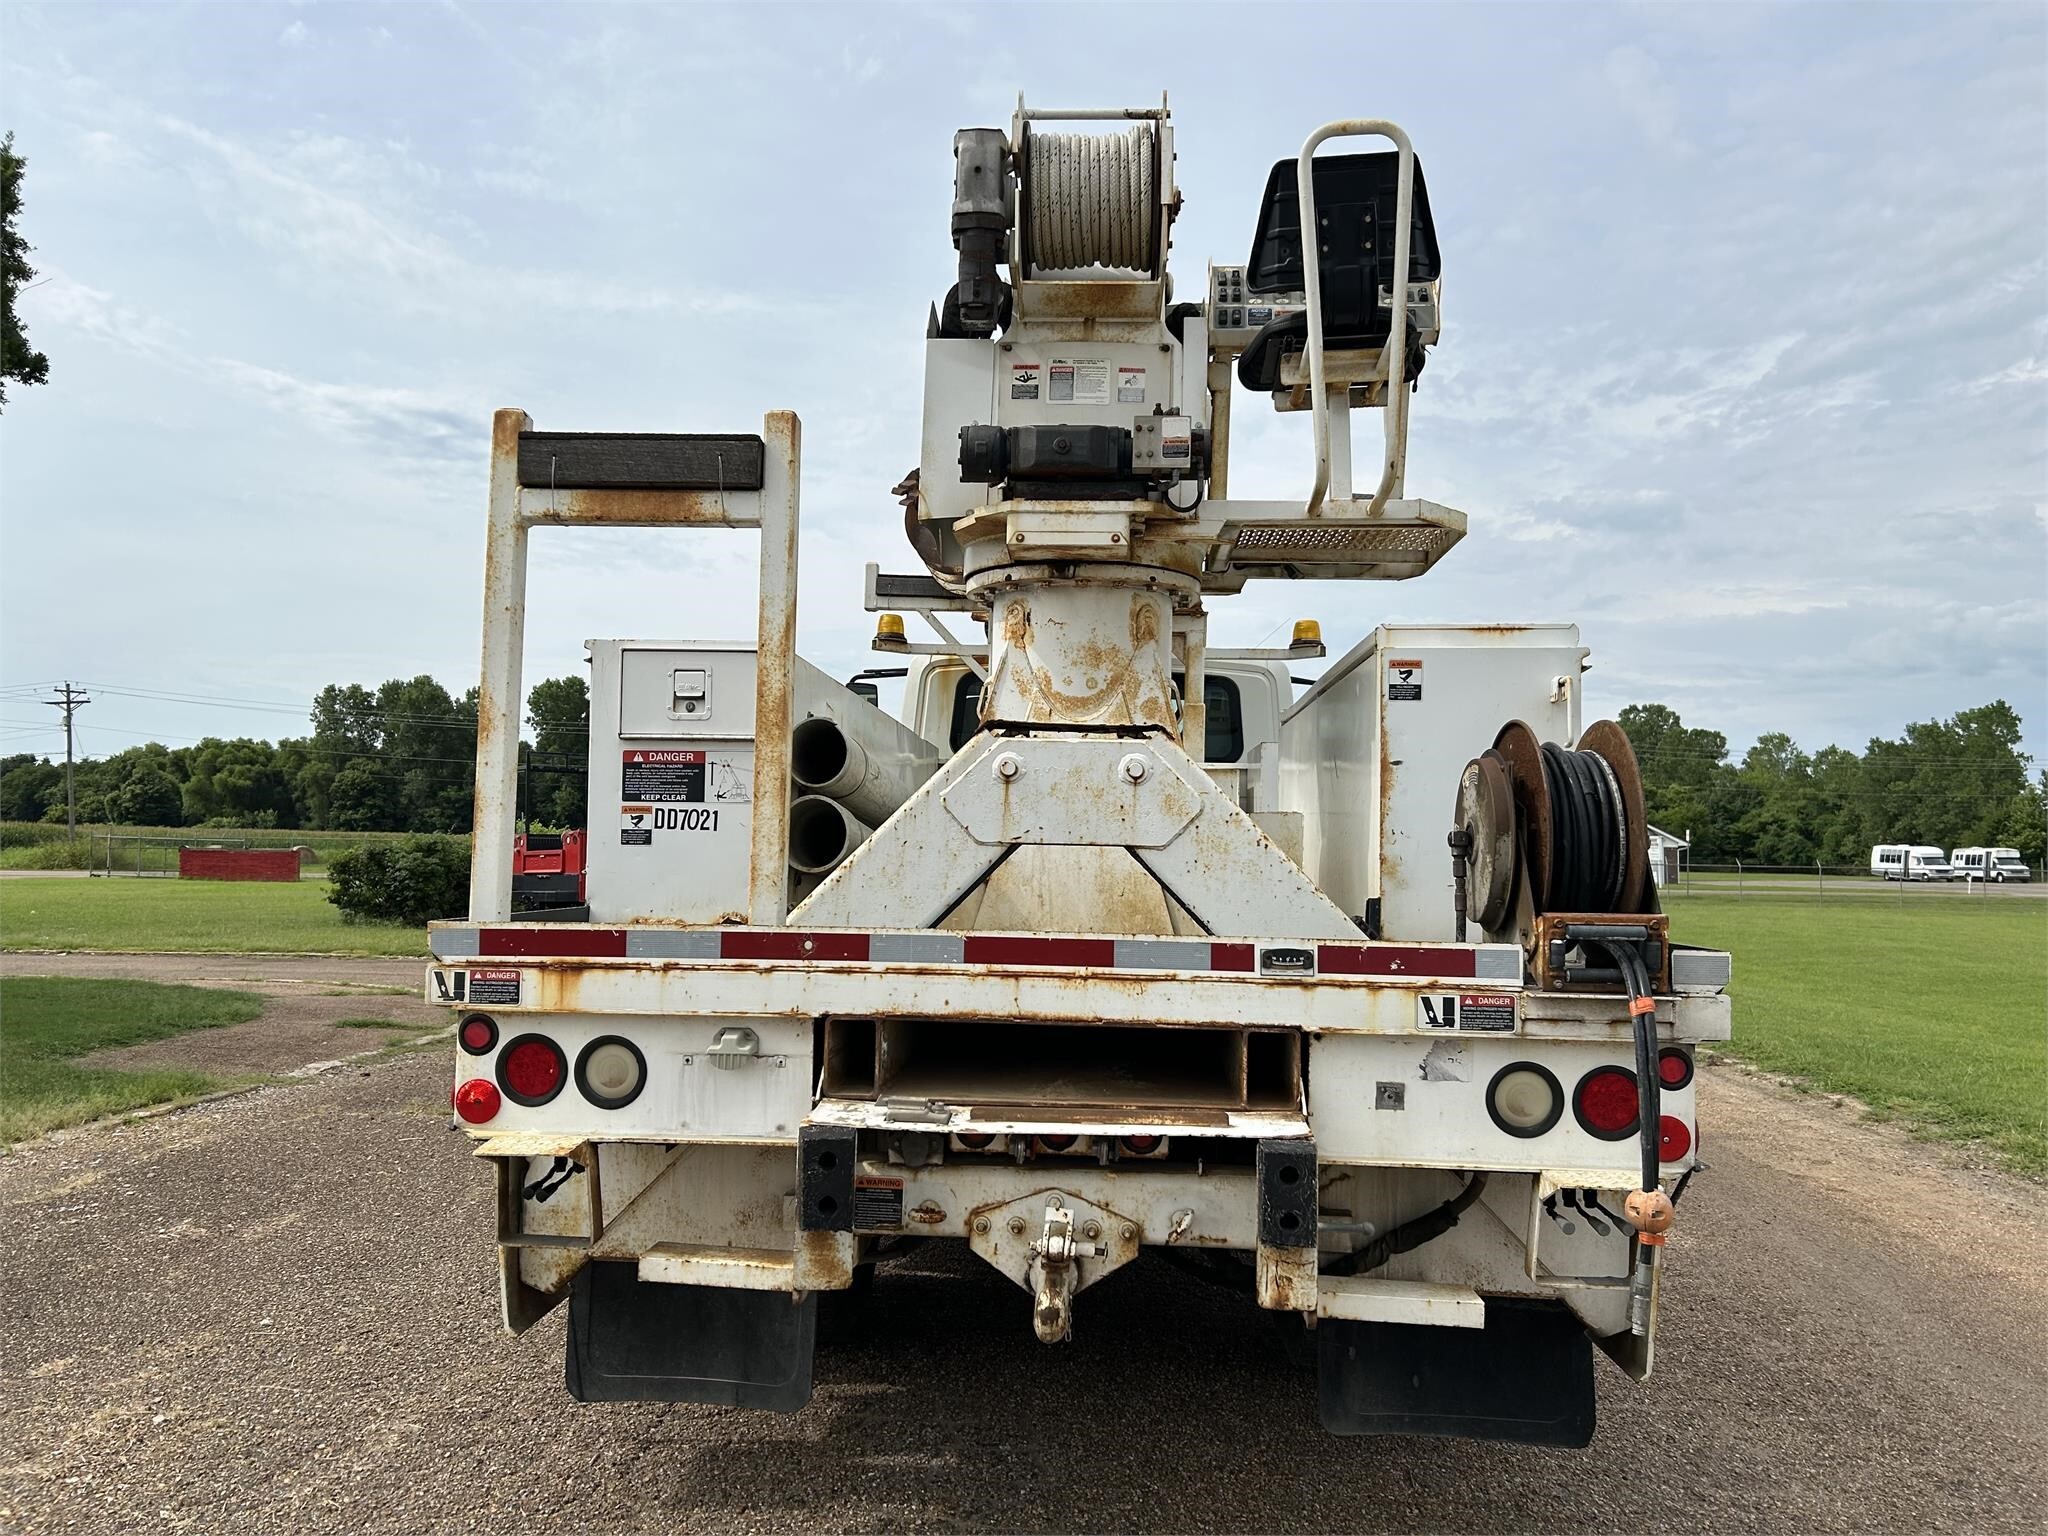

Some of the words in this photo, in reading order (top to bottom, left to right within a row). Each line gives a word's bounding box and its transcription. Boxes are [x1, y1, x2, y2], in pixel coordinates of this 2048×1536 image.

[649, 752, 694, 762] DANGER
[654, 808, 719, 832] DD7021
[486, 971, 516, 979] DANGER
[1478, 997, 1511, 1005] DANGER
[865, 1179, 901, 1187] WARNING
